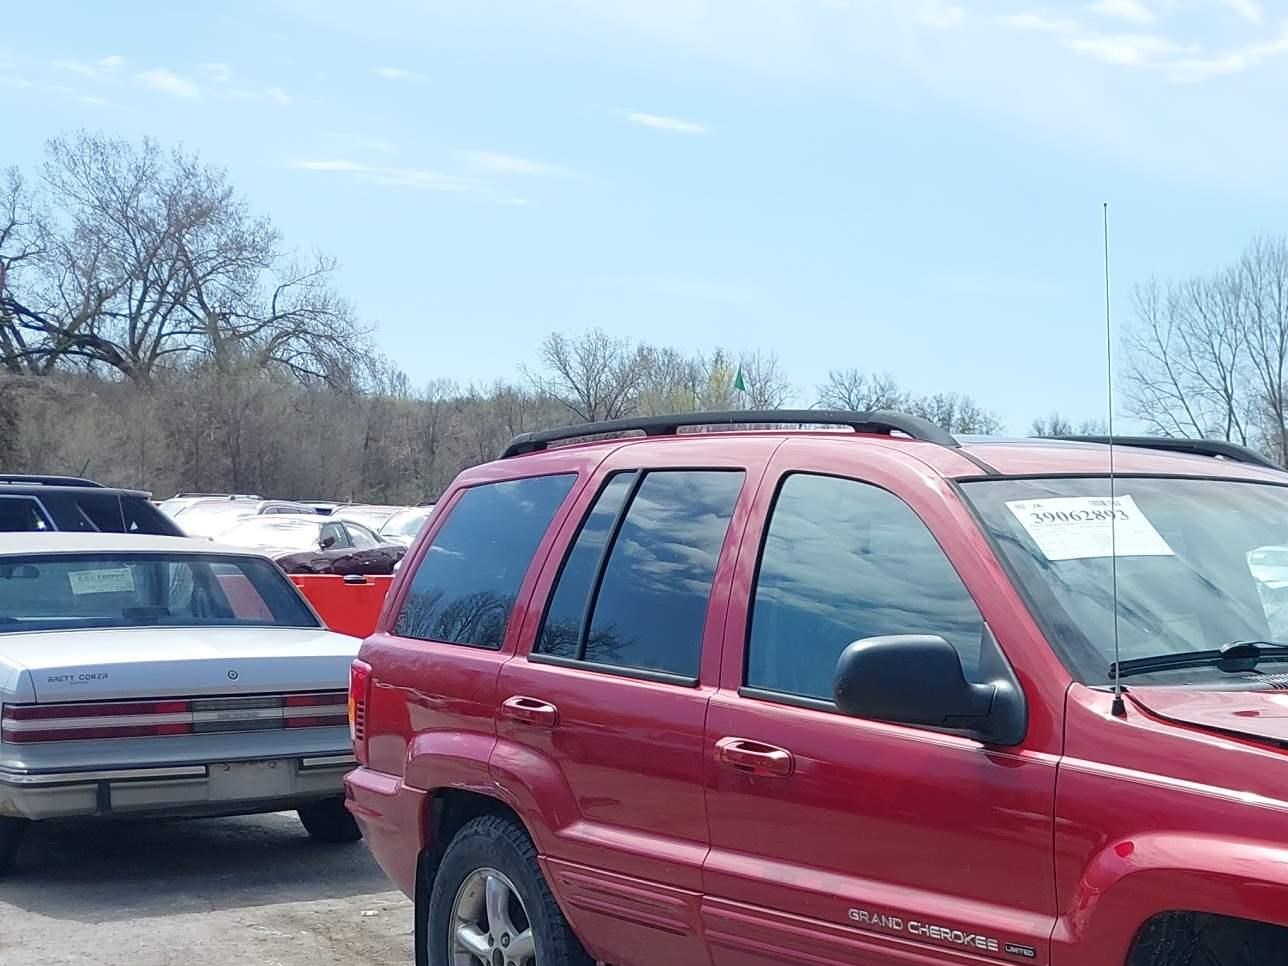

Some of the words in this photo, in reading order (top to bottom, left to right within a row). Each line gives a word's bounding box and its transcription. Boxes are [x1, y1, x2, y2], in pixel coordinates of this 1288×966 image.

[1030, 510, 1129, 524] 39062893
[47, 675, 74, 683] BRETT
[848, 908, 903, 930] GRAND
[907, 921, 999, 952] CHEROKEE
[1005, 945, 1035, 957] LIMITED
